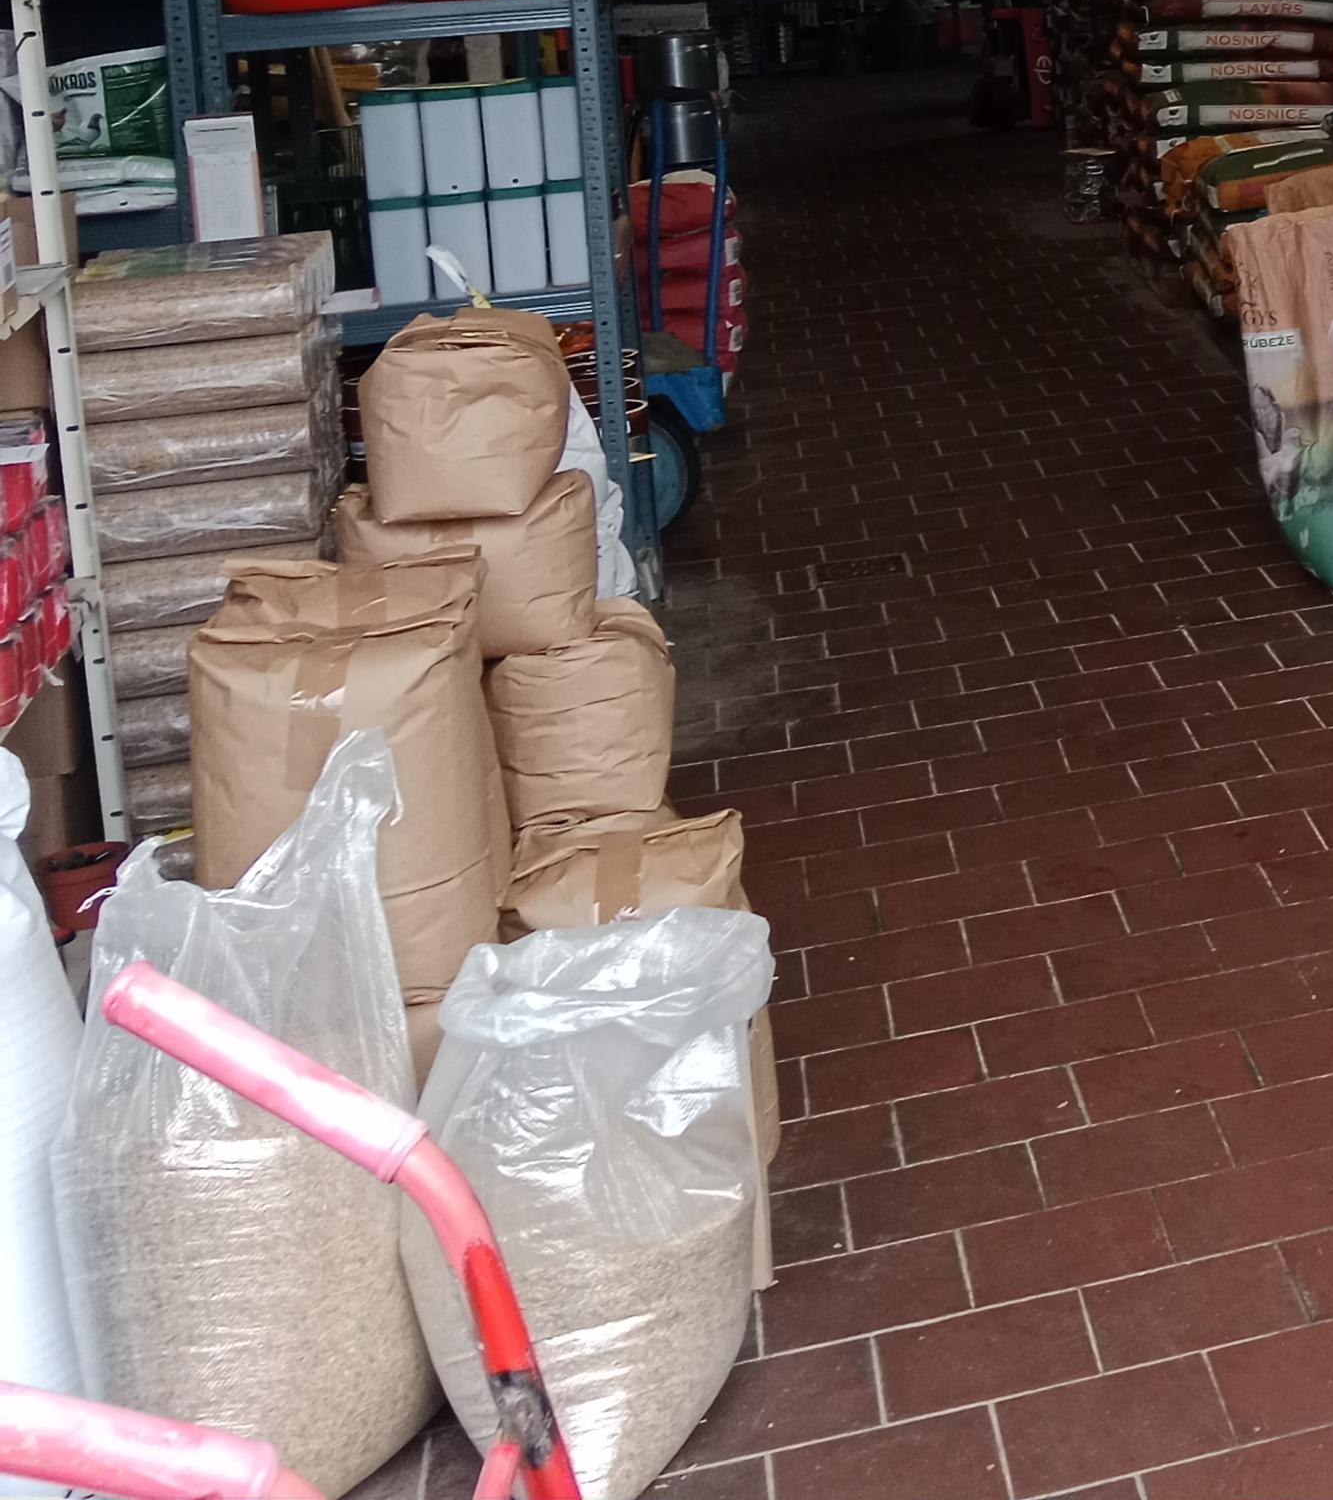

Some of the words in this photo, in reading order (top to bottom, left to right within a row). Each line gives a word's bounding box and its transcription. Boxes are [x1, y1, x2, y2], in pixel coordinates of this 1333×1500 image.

[1238, 1, 1303, 15] LAYERS
[1205, 33, 1281, 47] NOSNICE
[1210, 62, 1288, 77] NOSNICE
[1228, 108, 1309, 121] NOSNICE
